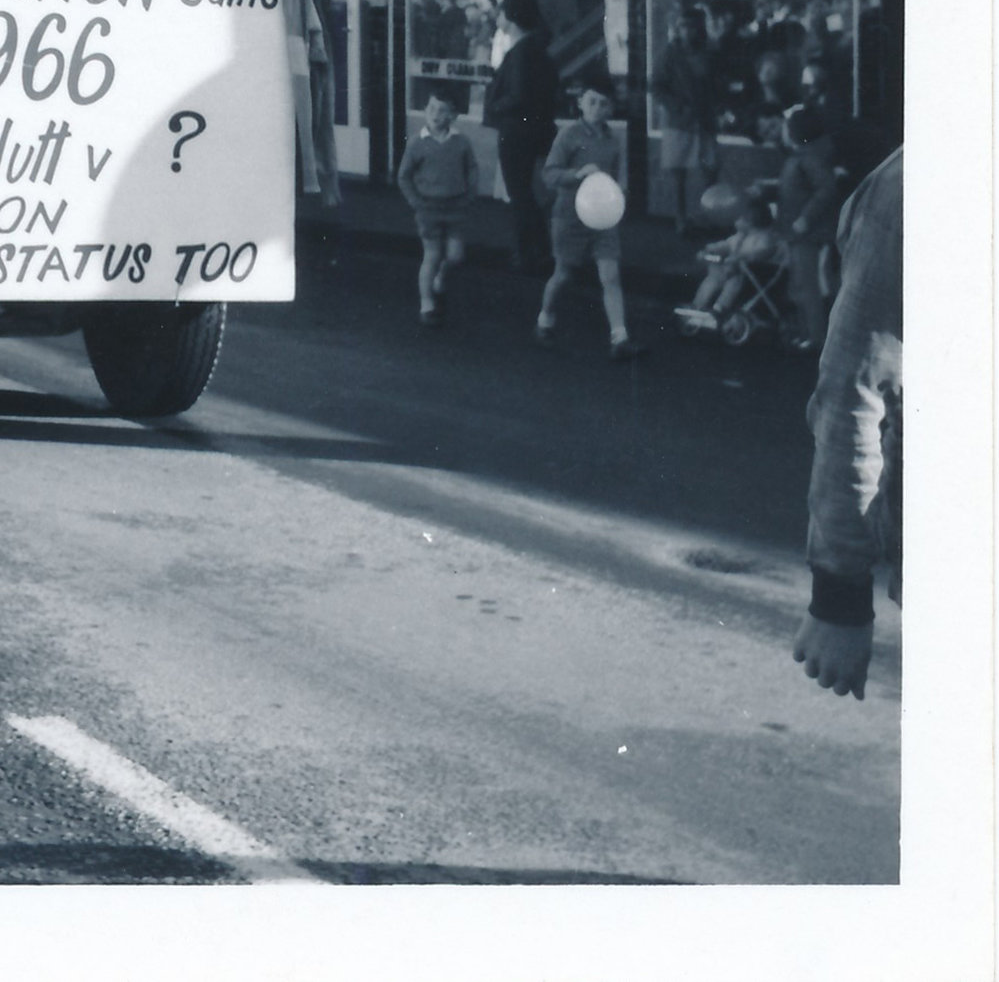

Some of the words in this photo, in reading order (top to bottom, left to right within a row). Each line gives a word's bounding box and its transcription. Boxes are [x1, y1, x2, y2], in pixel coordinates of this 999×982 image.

[87, 144, 112, 182] v
[168, 110, 207, 173] ?
[175, 241, 259, 285] TOO
